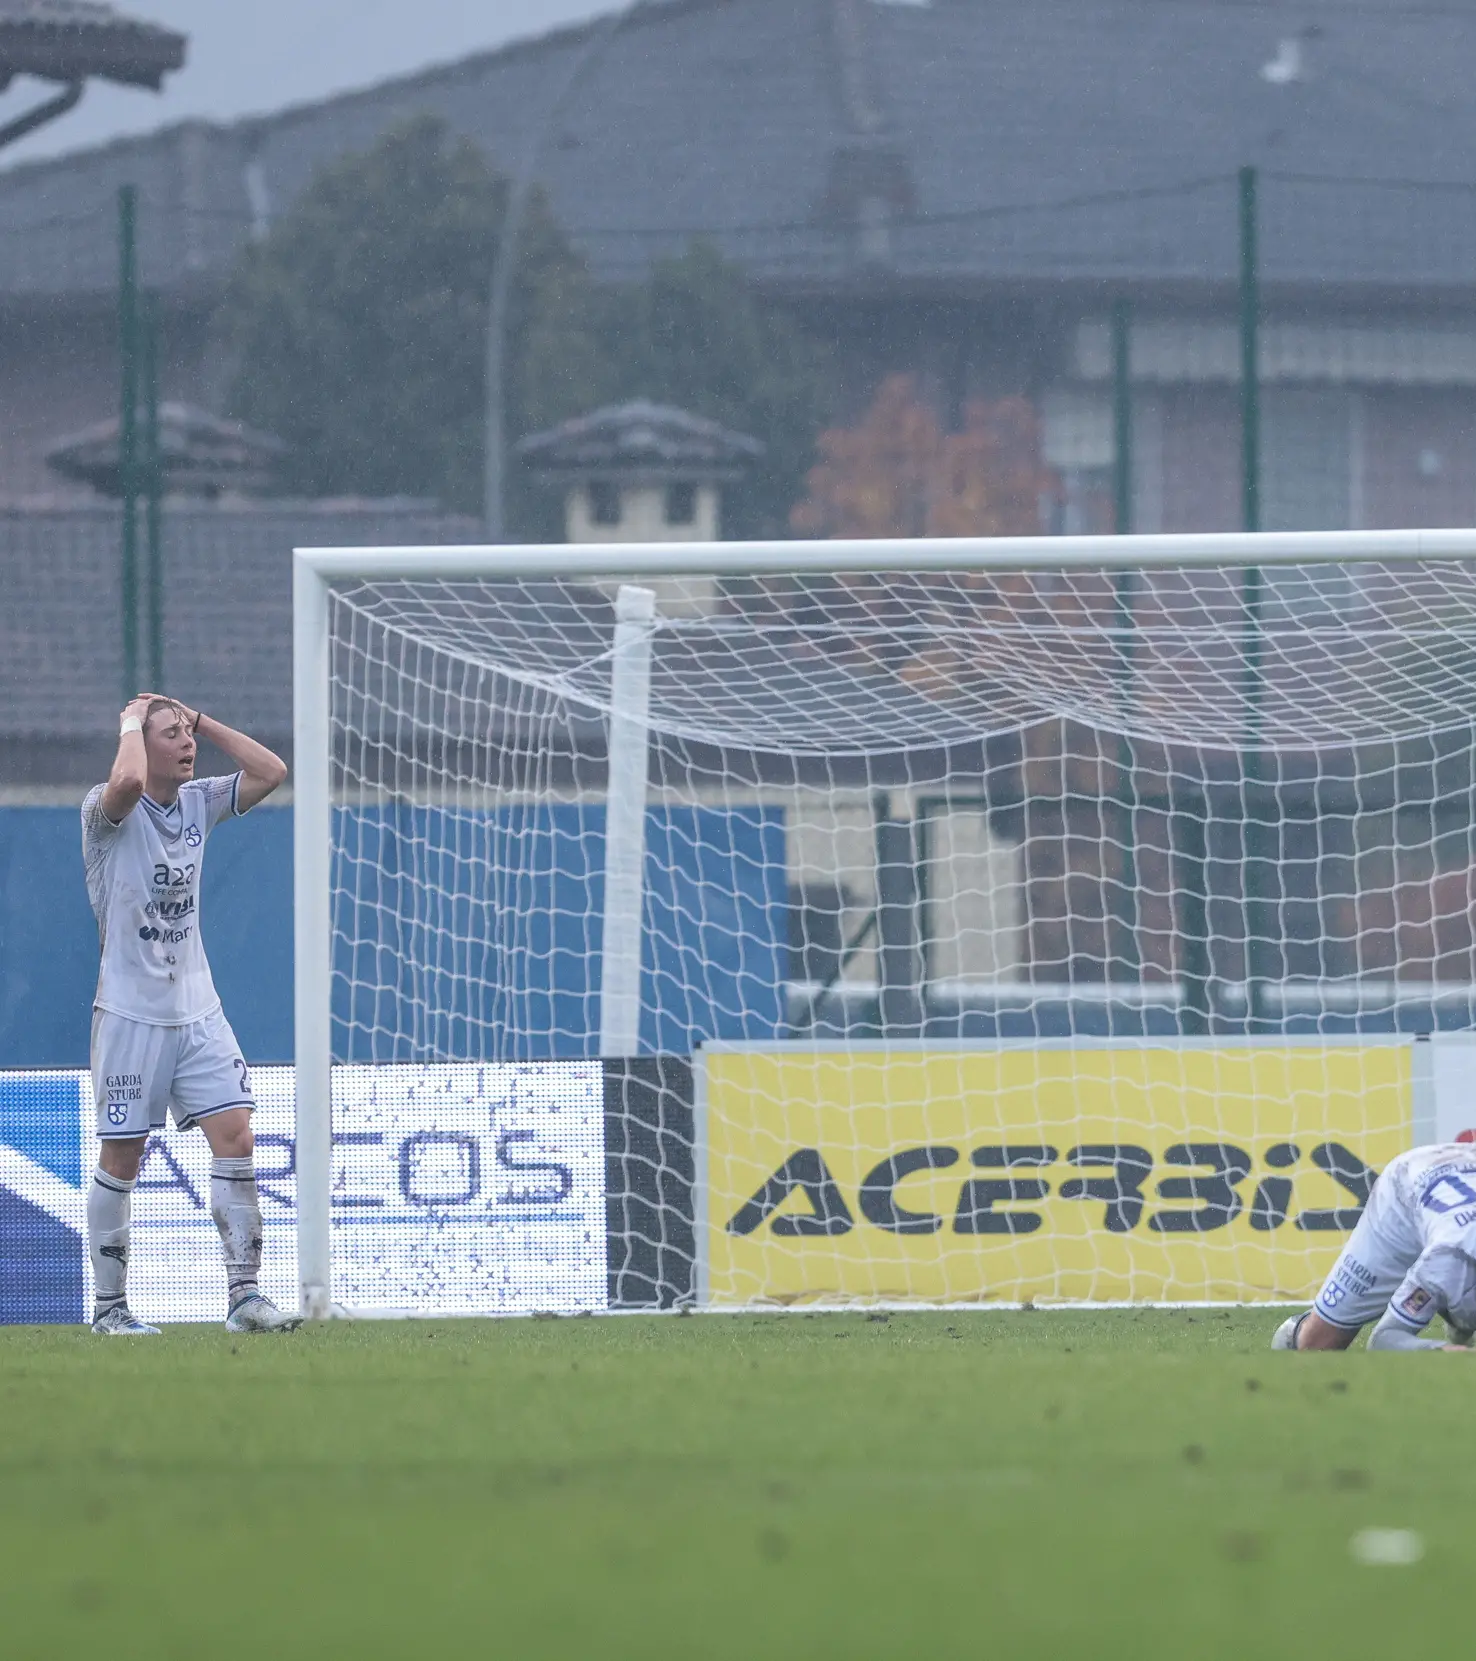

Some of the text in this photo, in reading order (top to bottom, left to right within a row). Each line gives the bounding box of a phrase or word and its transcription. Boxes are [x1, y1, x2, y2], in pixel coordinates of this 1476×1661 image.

[106, 1074, 143, 1088] GARDA
[107, 1088, 142, 1101] STUBE
[1343, 1253, 1378, 1287] GARDA
